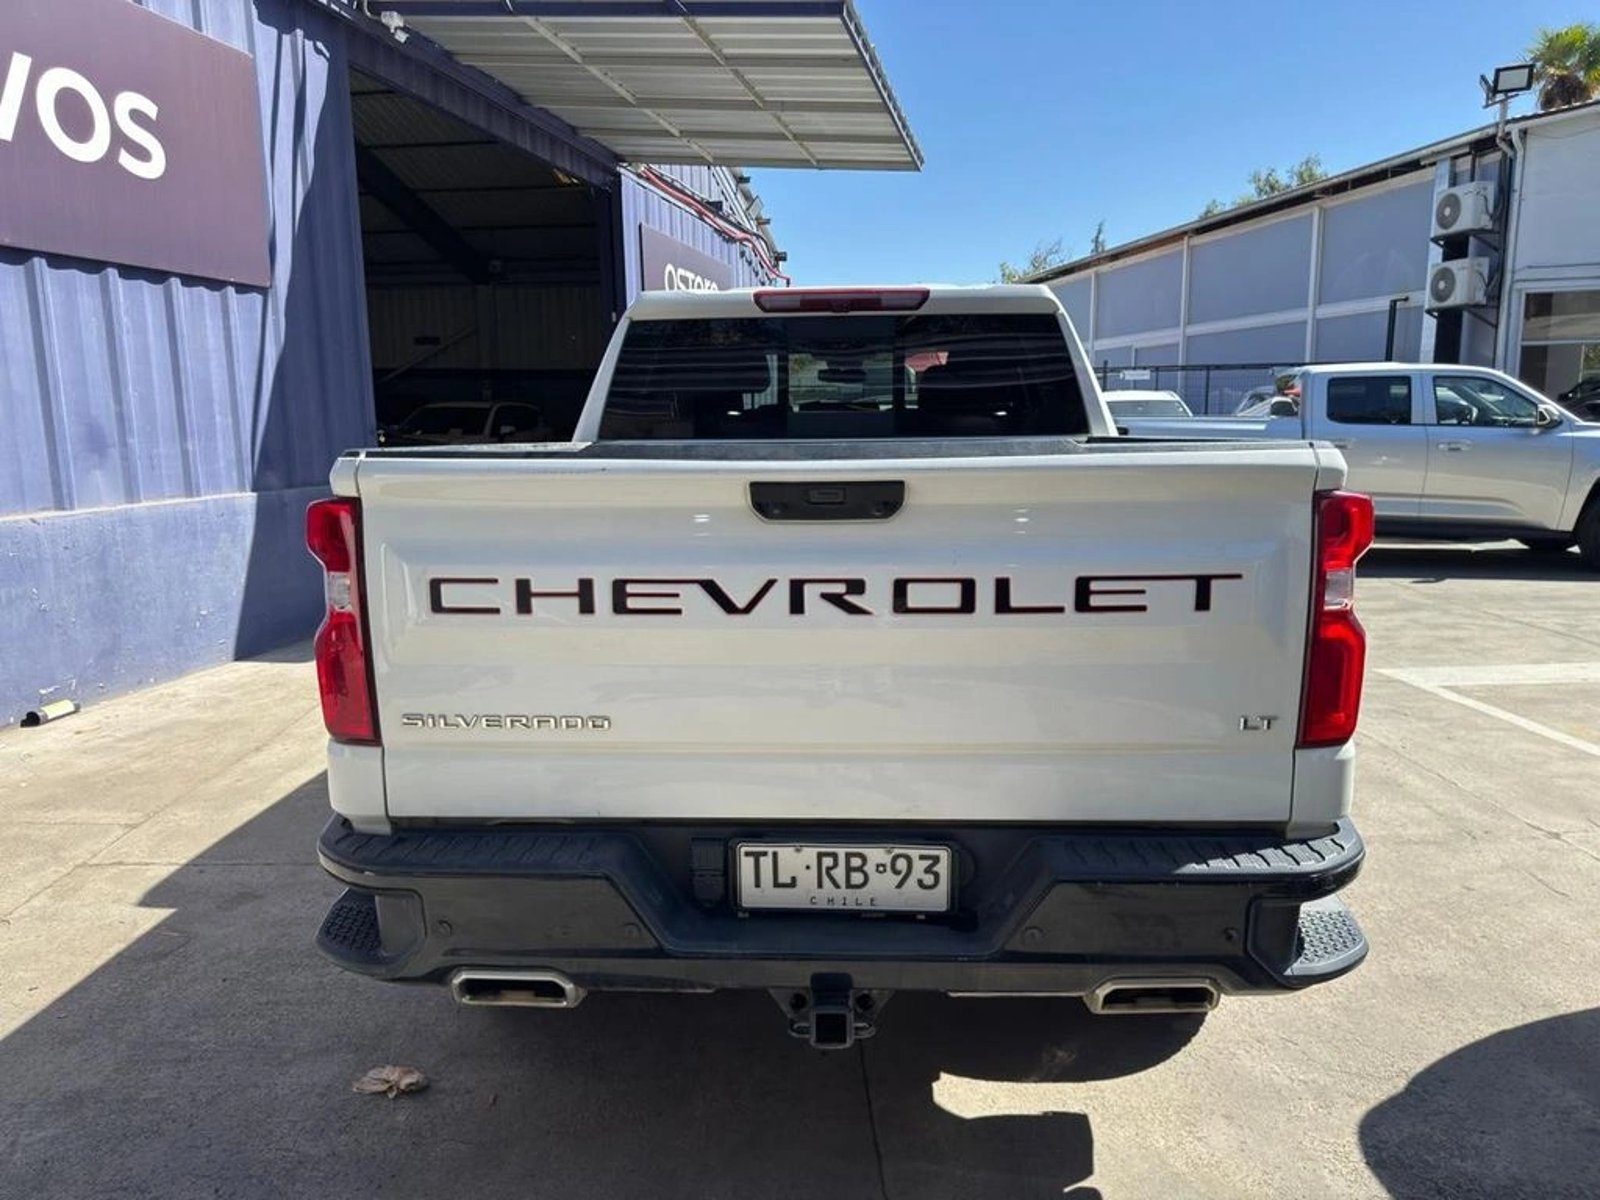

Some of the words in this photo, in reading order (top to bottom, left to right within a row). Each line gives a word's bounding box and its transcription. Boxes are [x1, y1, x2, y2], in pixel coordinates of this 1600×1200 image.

[429, 574, 1243, 615] CHEVROLET
[401, 713, 611, 730] SILVERADO
[1239, 715, 1278, 731] LT
[809, 896, 879, 907] CHILE
